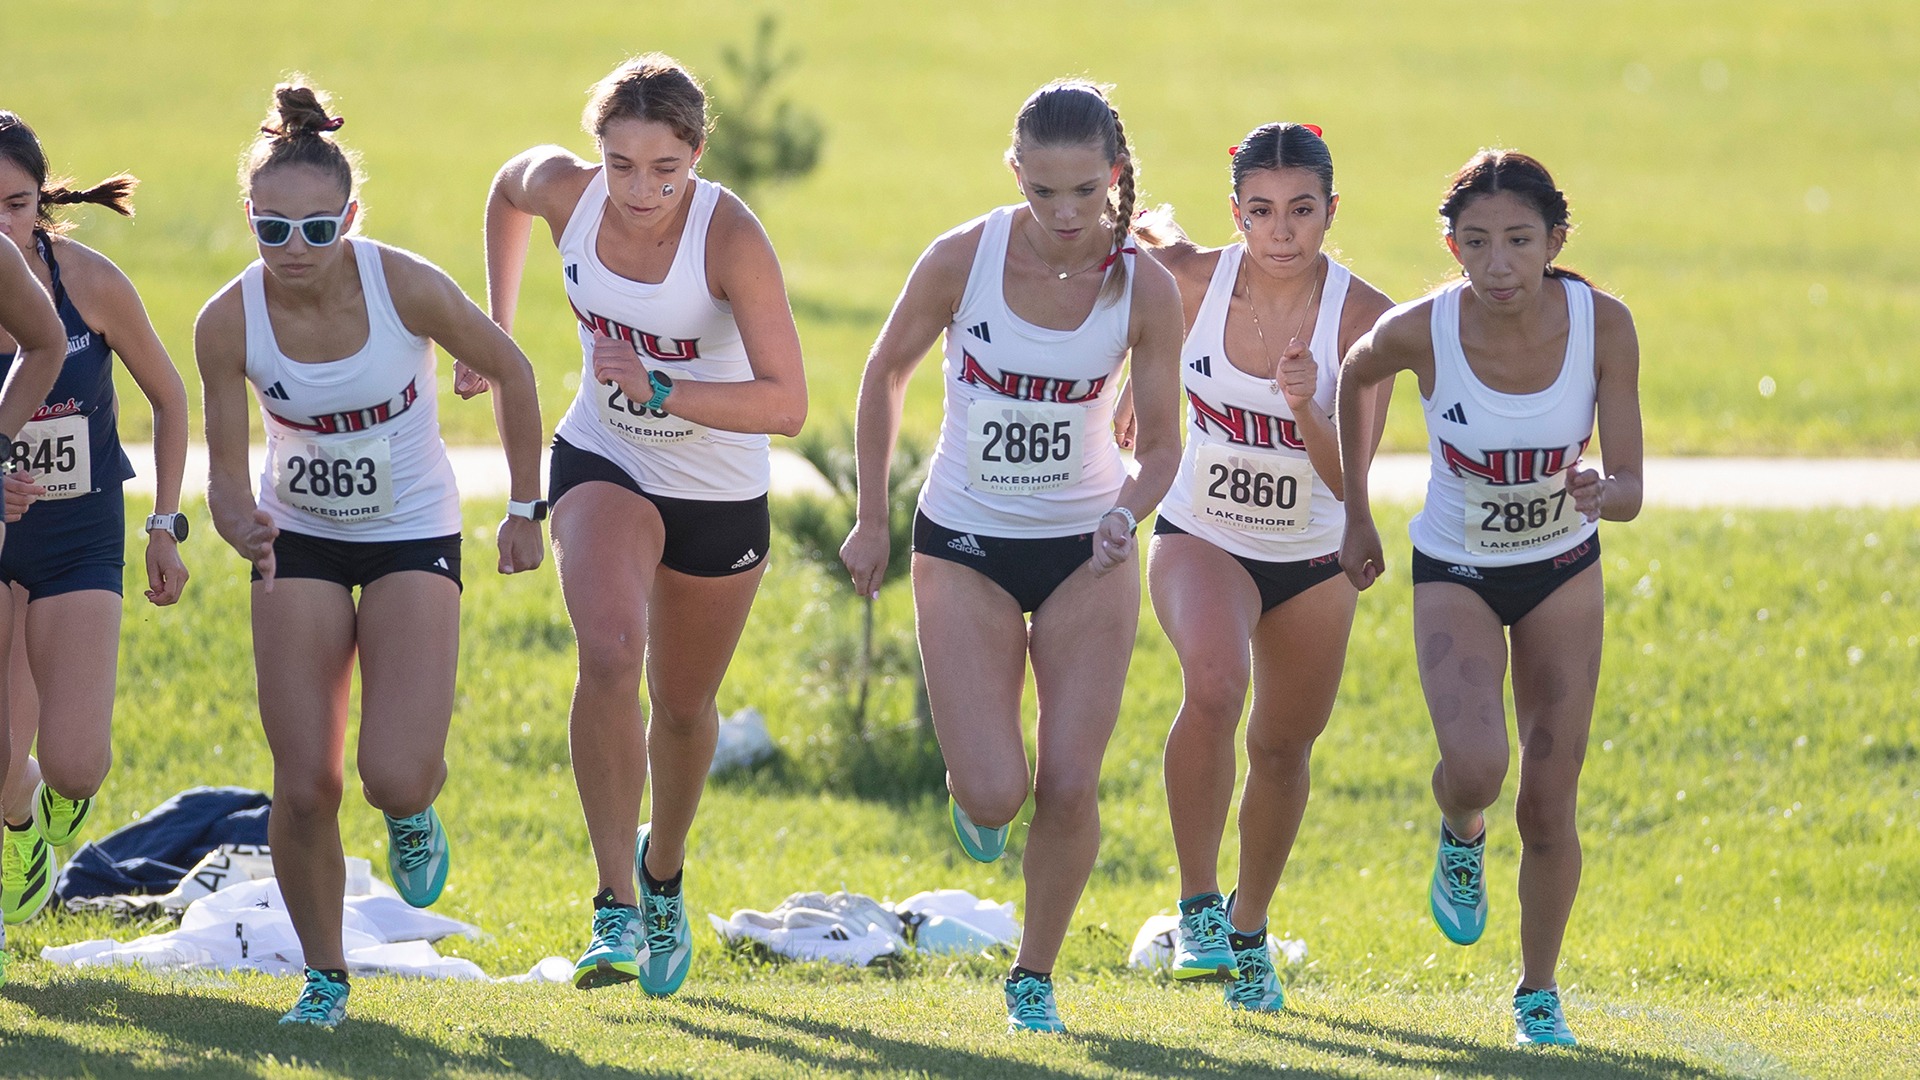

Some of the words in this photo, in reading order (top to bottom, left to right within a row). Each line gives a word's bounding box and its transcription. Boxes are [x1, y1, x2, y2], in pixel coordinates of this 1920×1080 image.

[66, 332, 90, 354] ALLEY
[957, 345, 1110, 404] NIU
[609, 419, 694, 438] LAKESHORE
[11, 435, 76, 474] 845
[982, 420, 1072, 464] 2865
[1438, 434, 1592, 485] NIU
[288, 456, 377, 497] 2863
[981, 472, 1070, 484] LAKESHORE
[1208, 464, 1297, 510] 2860
[292, 503, 380, 517] LAKESHORE
[1206, 507, 1295, 526] LAKESHORE
[1481, 488, 1567, 533] 2867
[1216, 518, 1247, 529] ATHLETIC
[947, 541, 986, 557] adidas
[1481, 526, 1569, 549] LAKESHORE
[1553, 541, 1591, 570] NIU
